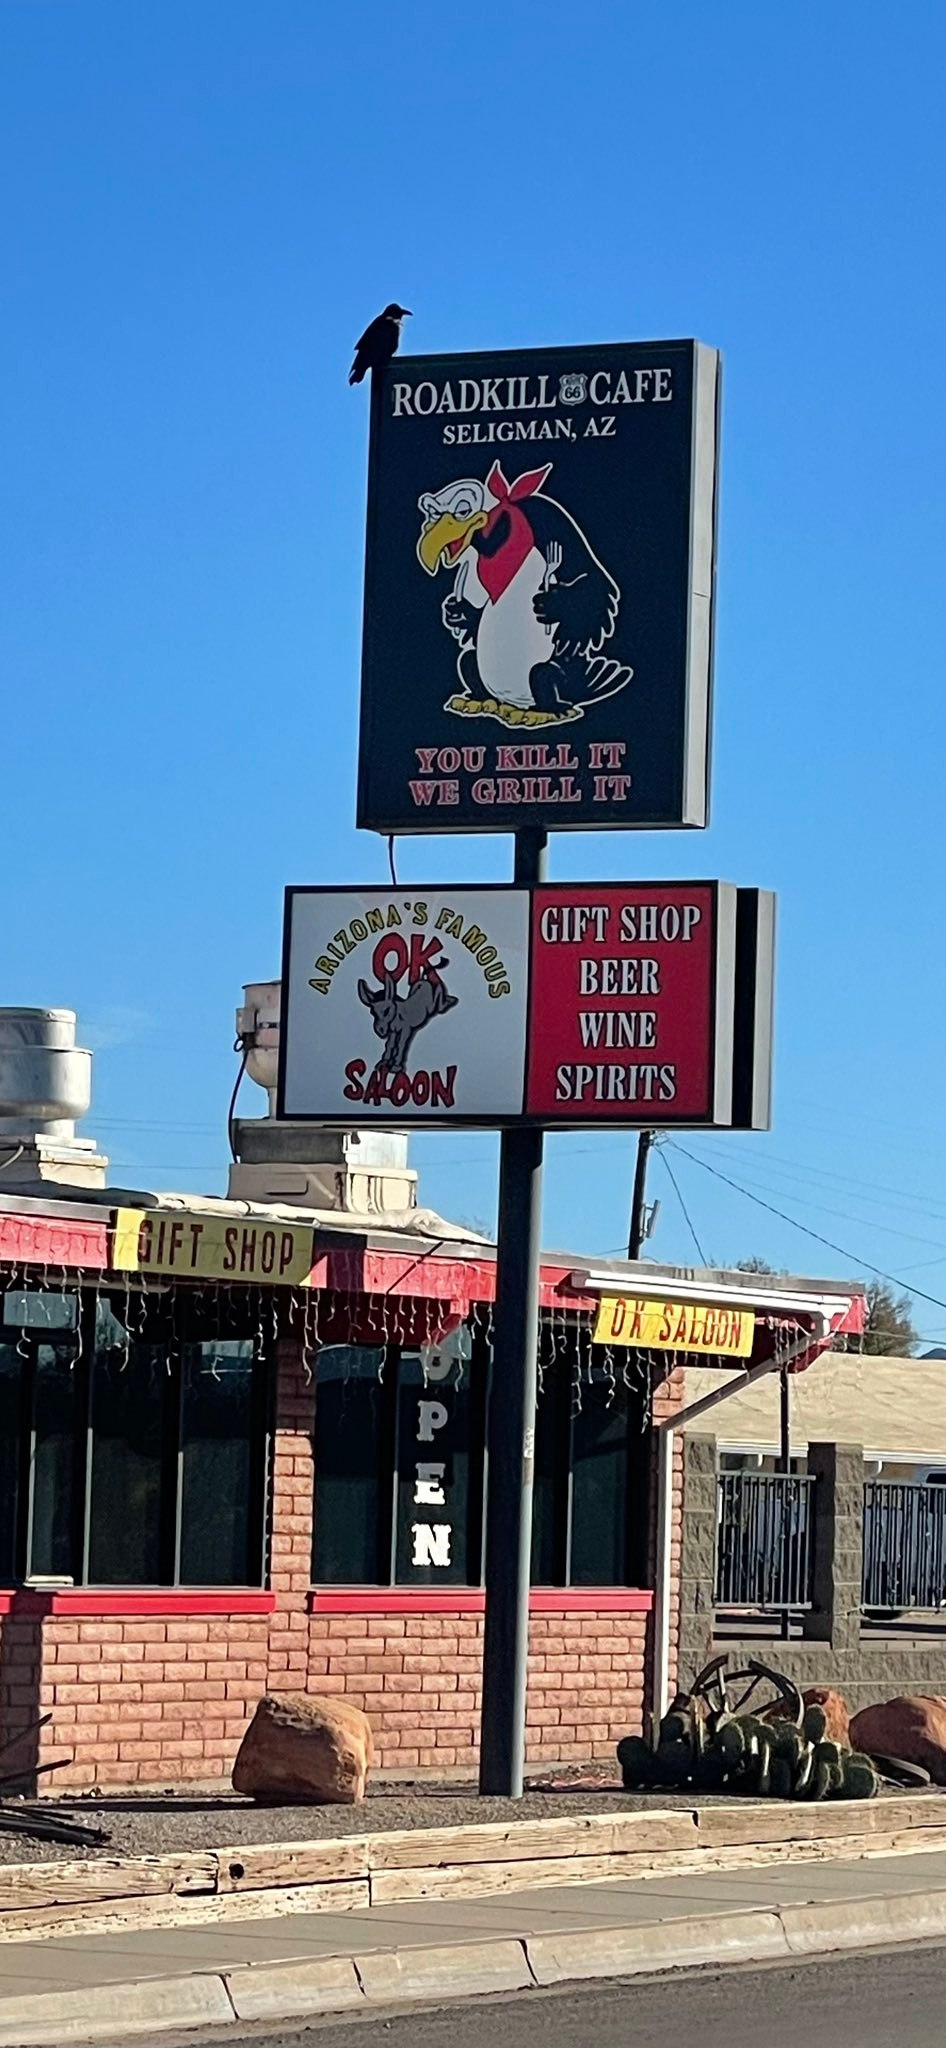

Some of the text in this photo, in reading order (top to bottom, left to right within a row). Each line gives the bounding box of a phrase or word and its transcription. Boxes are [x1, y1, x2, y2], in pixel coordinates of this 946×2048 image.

[392, 375, 557, 416] ROADKILL
[589, 369, 673, 405] CAFE
[443, 416, 617, 445] SELIGMAN, AZ
[415, 743, 626, 774] YOU KILL IT
[409, 775, 631, 806] WE GRILL IT
[540, 905, 701, 942] GIFT SHOP
[309, 902, 511, 998] ARIZONA'S FAMOUS
[372, 932, 444, 987] OK
[580, 959, 661, 995] BEER
[578, 1012, 656, 1047] WINE
[343, 1059, 457, 1108] SALOON
[555, 1064, 676, 1101] SPIRITS
[138, 1219, 294, 1276] GIFT SHOP
[659, 1303, 742, 1349] SALOON
[412, 1330, 454, 1567] OPEN
